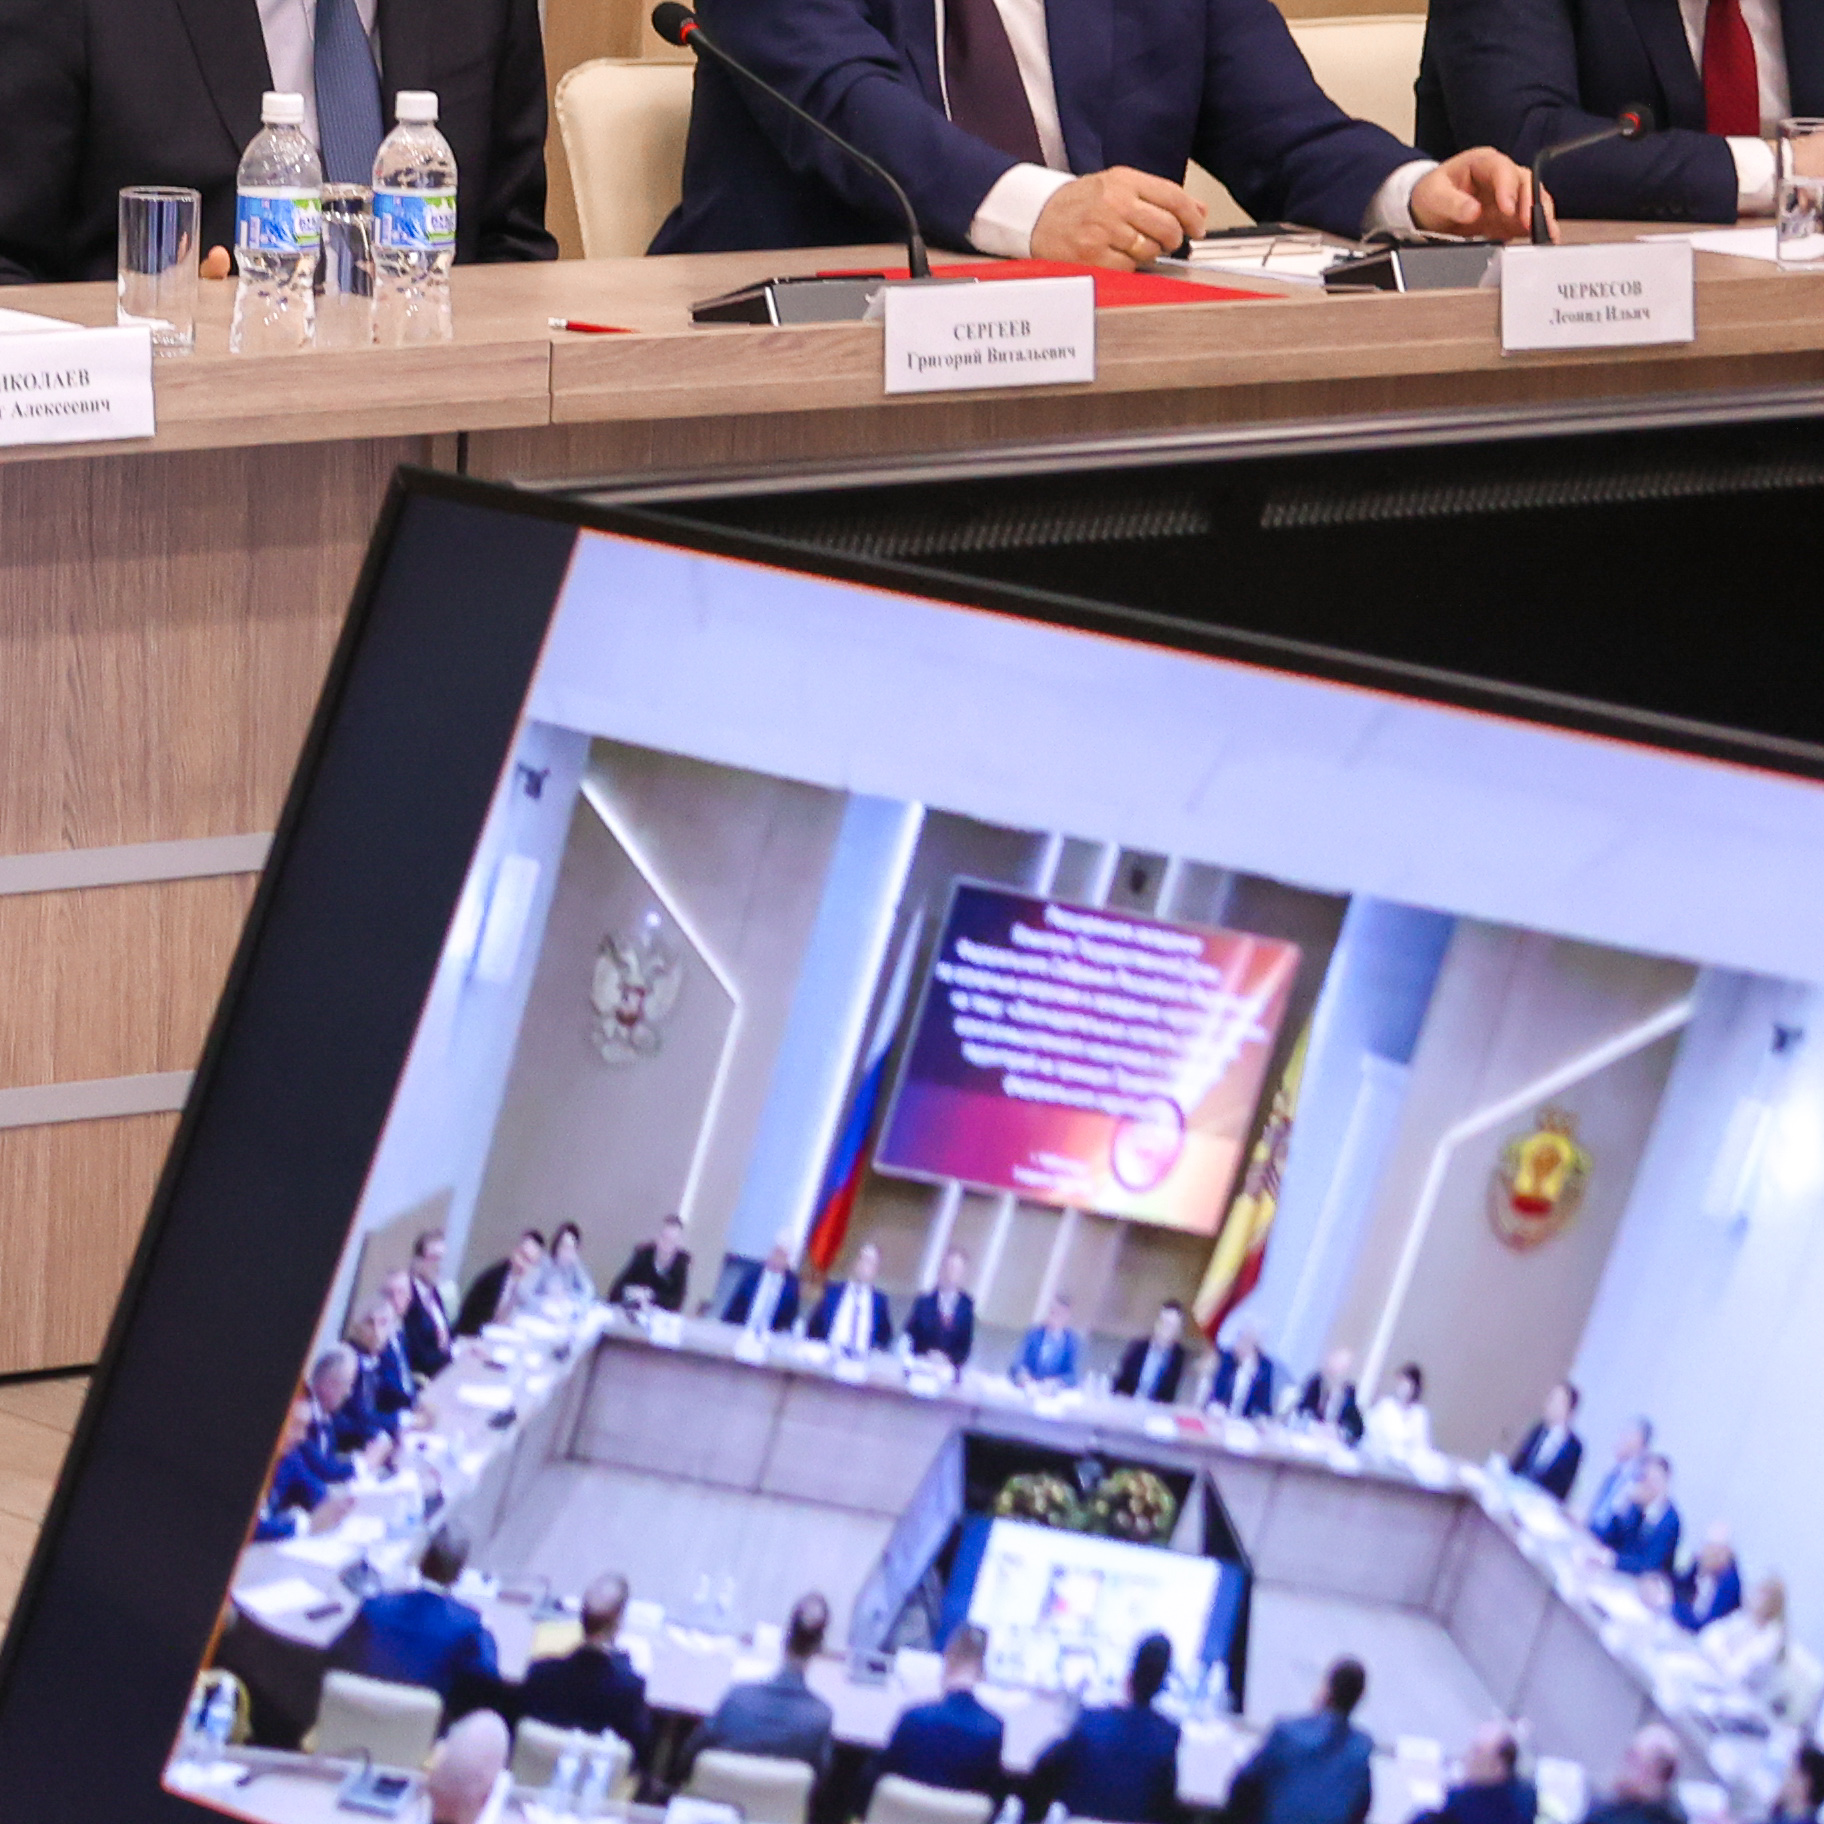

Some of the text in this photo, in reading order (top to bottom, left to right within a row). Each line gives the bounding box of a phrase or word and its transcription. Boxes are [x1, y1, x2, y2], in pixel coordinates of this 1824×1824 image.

[1557, 281, 1643, 300] ЧЕРКЕСОВ
[953, 320, 1031, 341] СЕРГЕЕВ
[907, 347, 983, 373] Григорий
[11, 398, 111, 420] Алексеевич
